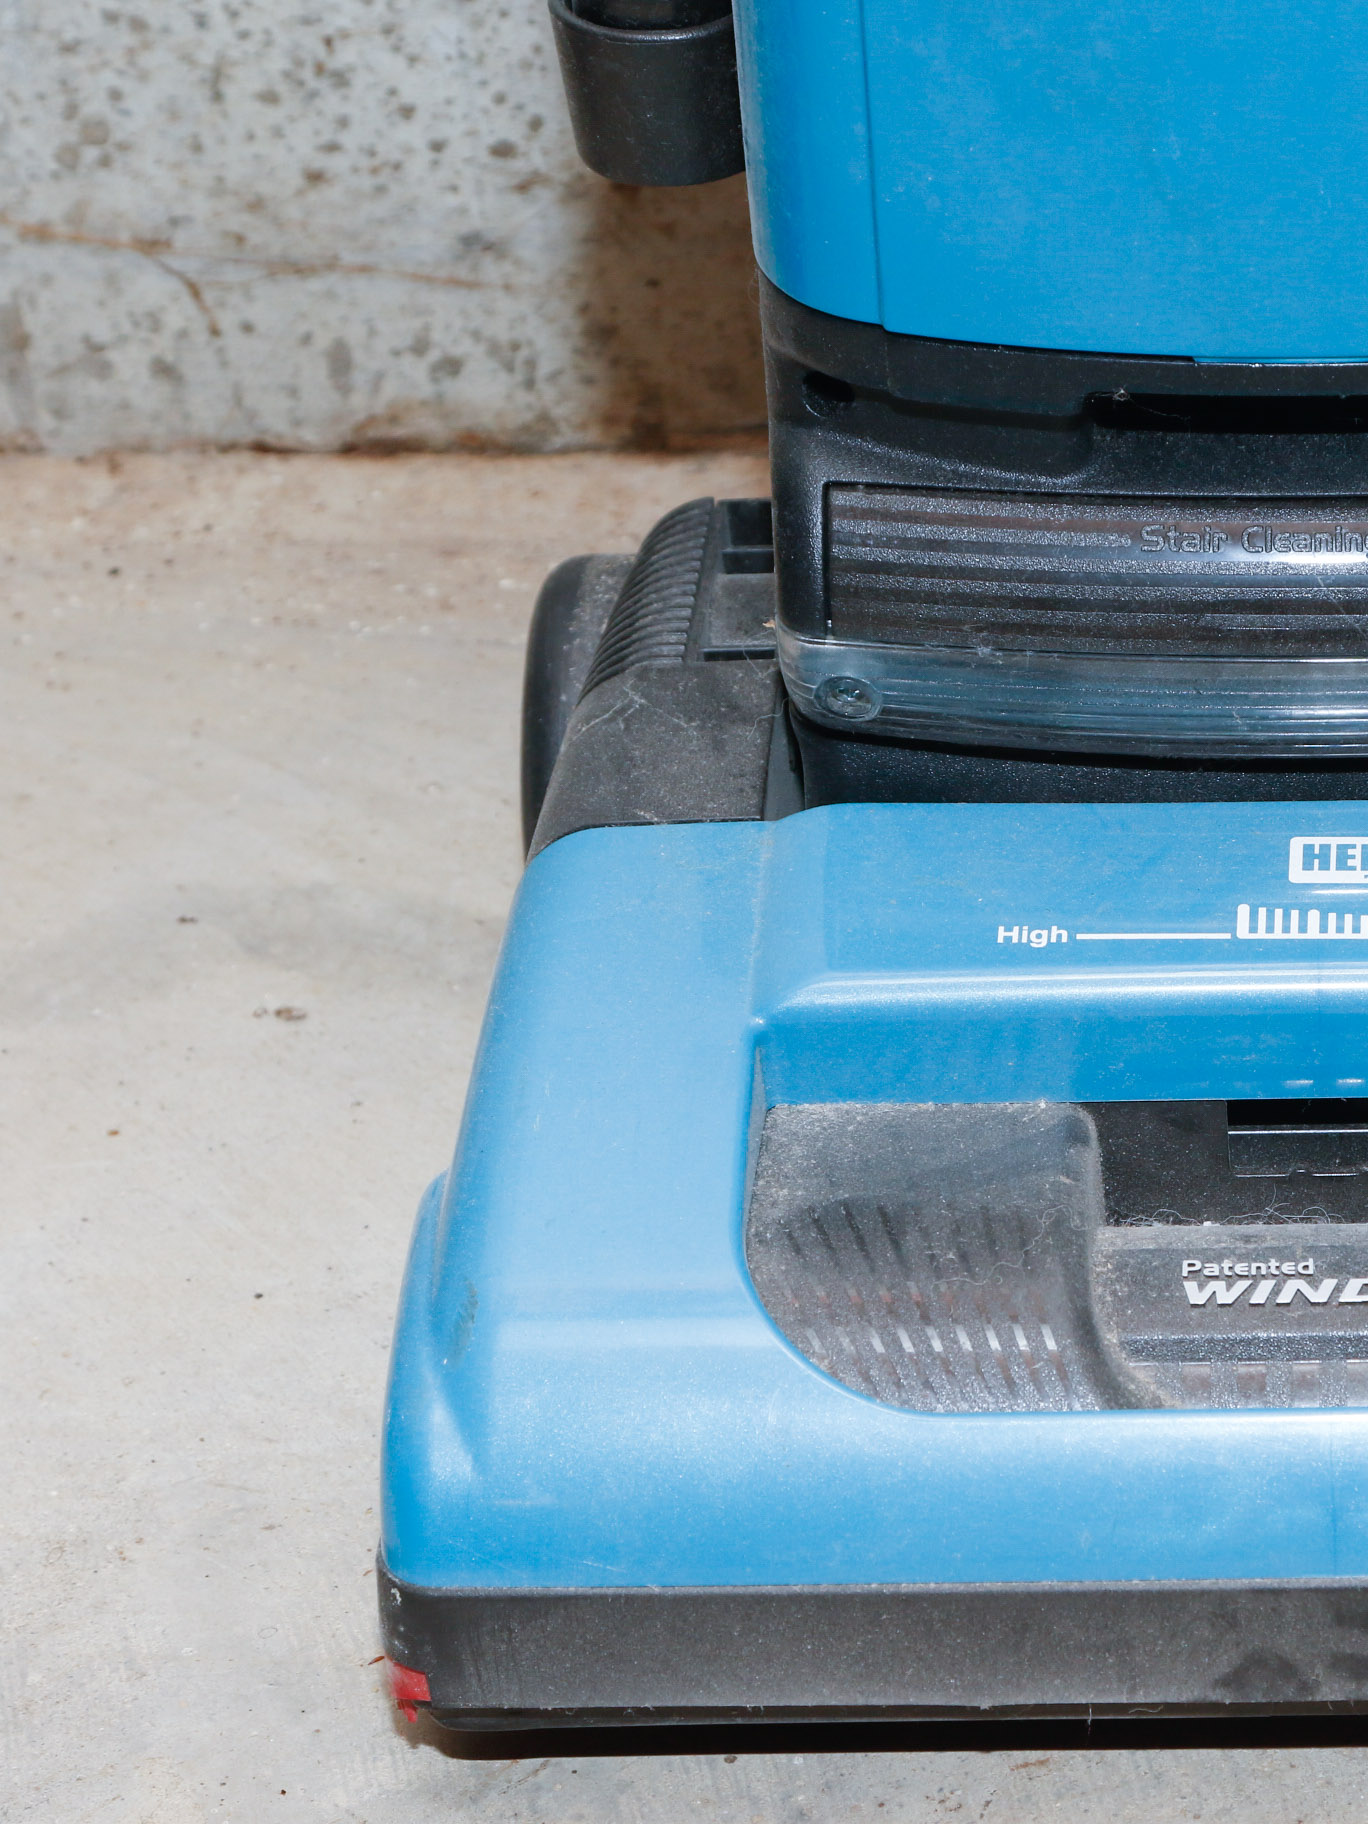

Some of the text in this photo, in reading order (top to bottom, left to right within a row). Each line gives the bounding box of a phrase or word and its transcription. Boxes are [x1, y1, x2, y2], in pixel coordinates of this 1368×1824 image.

[1140, 523, 1228, 553] Stair
[997, 925, 1069, 948] High
[1181, 1258, 1316, 1278] Patented
